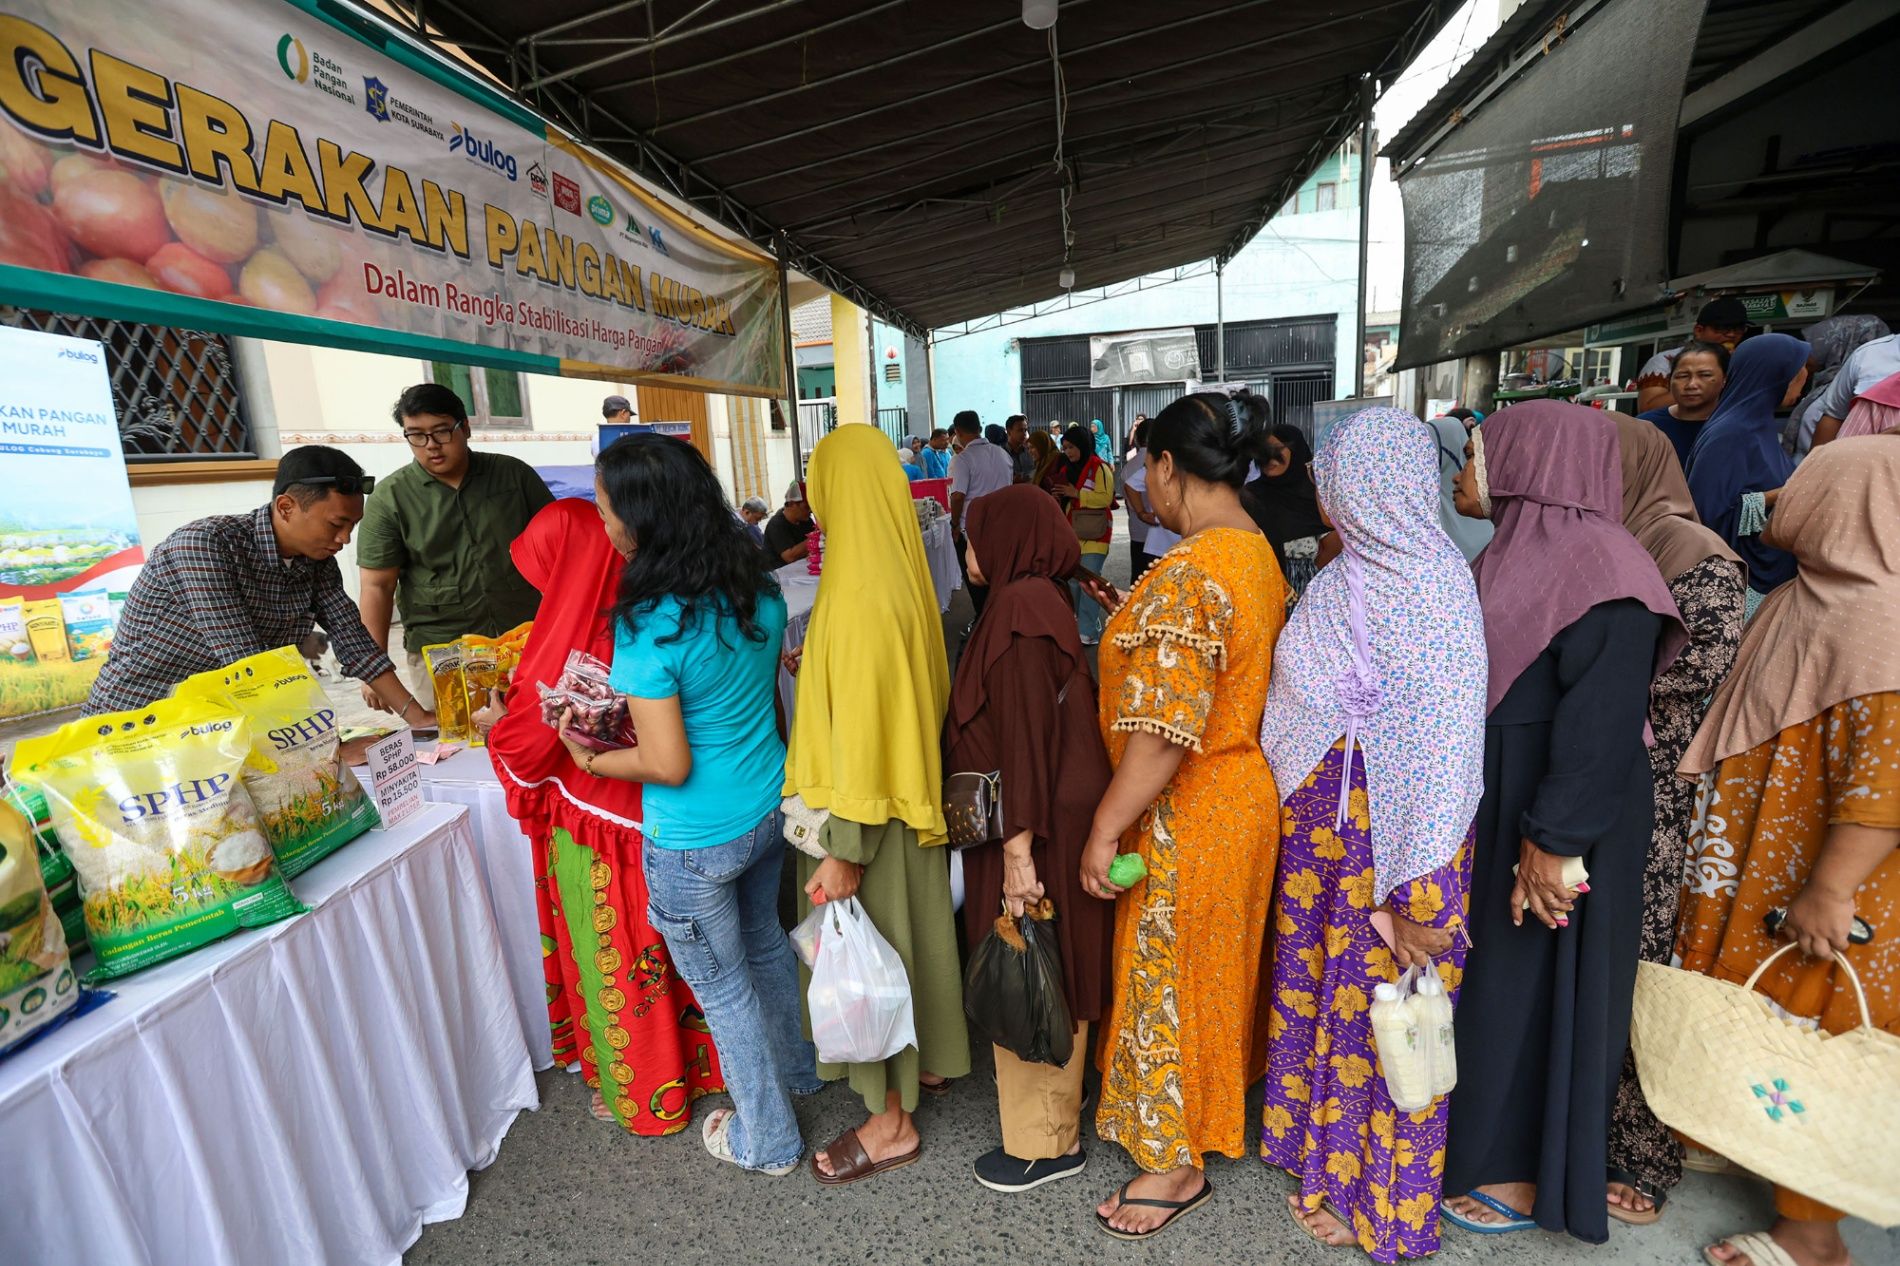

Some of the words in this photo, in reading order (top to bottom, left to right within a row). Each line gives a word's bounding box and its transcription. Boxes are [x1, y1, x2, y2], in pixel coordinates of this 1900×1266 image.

[313, 52, 342, 75] Badan
[313, 65, 348, 90] Pangan
[314, 78, 355, 106] Nasional
[390, 97, 433, 124] PEMERINTAH
[391, 110, 411, 126] KOTA
[411, 117, 445, 141] SURABAYA
[464, 127, 517, 181] bulog
[0, 13, 471, 259] GERAKAN
[484, 203, 645, 312] PANGAN
[650, 272, 736, 336] MURAH
[364, 262, 440, 307] Dalam
[446, 283, 514, 326] Rangka
[519, 302, 589, 340] Stabilisasi
[592, 318, 626, 348] Harga
[628, 333, 663, 355] Pangan
[66, 350, 98, 364] bulog
[3, 422, 66, 437] MURAH
[38, 408, 107, 425] PANGAN
[28, 446, 62, 455] Cabang
[280, 674, 308, 685] bulog
[190, 721, 232, 735] bulog
[268, 709, 336, 750] SPHP
[380, 739, 403, 757] BERAS
[383, 749, 402, 764] SPHP
[375, 771, 387, 781] Rp
[388, 753, 415, 774] 58.000
[380, 771, 417, 798] MINYAKITA
[381, 798, 392, 808] Rp
[393, 780, 419, 801] 15.500
[119, 773, 229, 823] SPHP
[321, 801, 332, 817] 5
[333, 800, 345, 811] kg
[173, 886, 190, 905] 5
[192, 884, 214, 899] kg
[102, 938, 145, 957] Cadangan
[146, 929, 173, 943] Beras
[174, 909, 225, 933] Pemerintah
